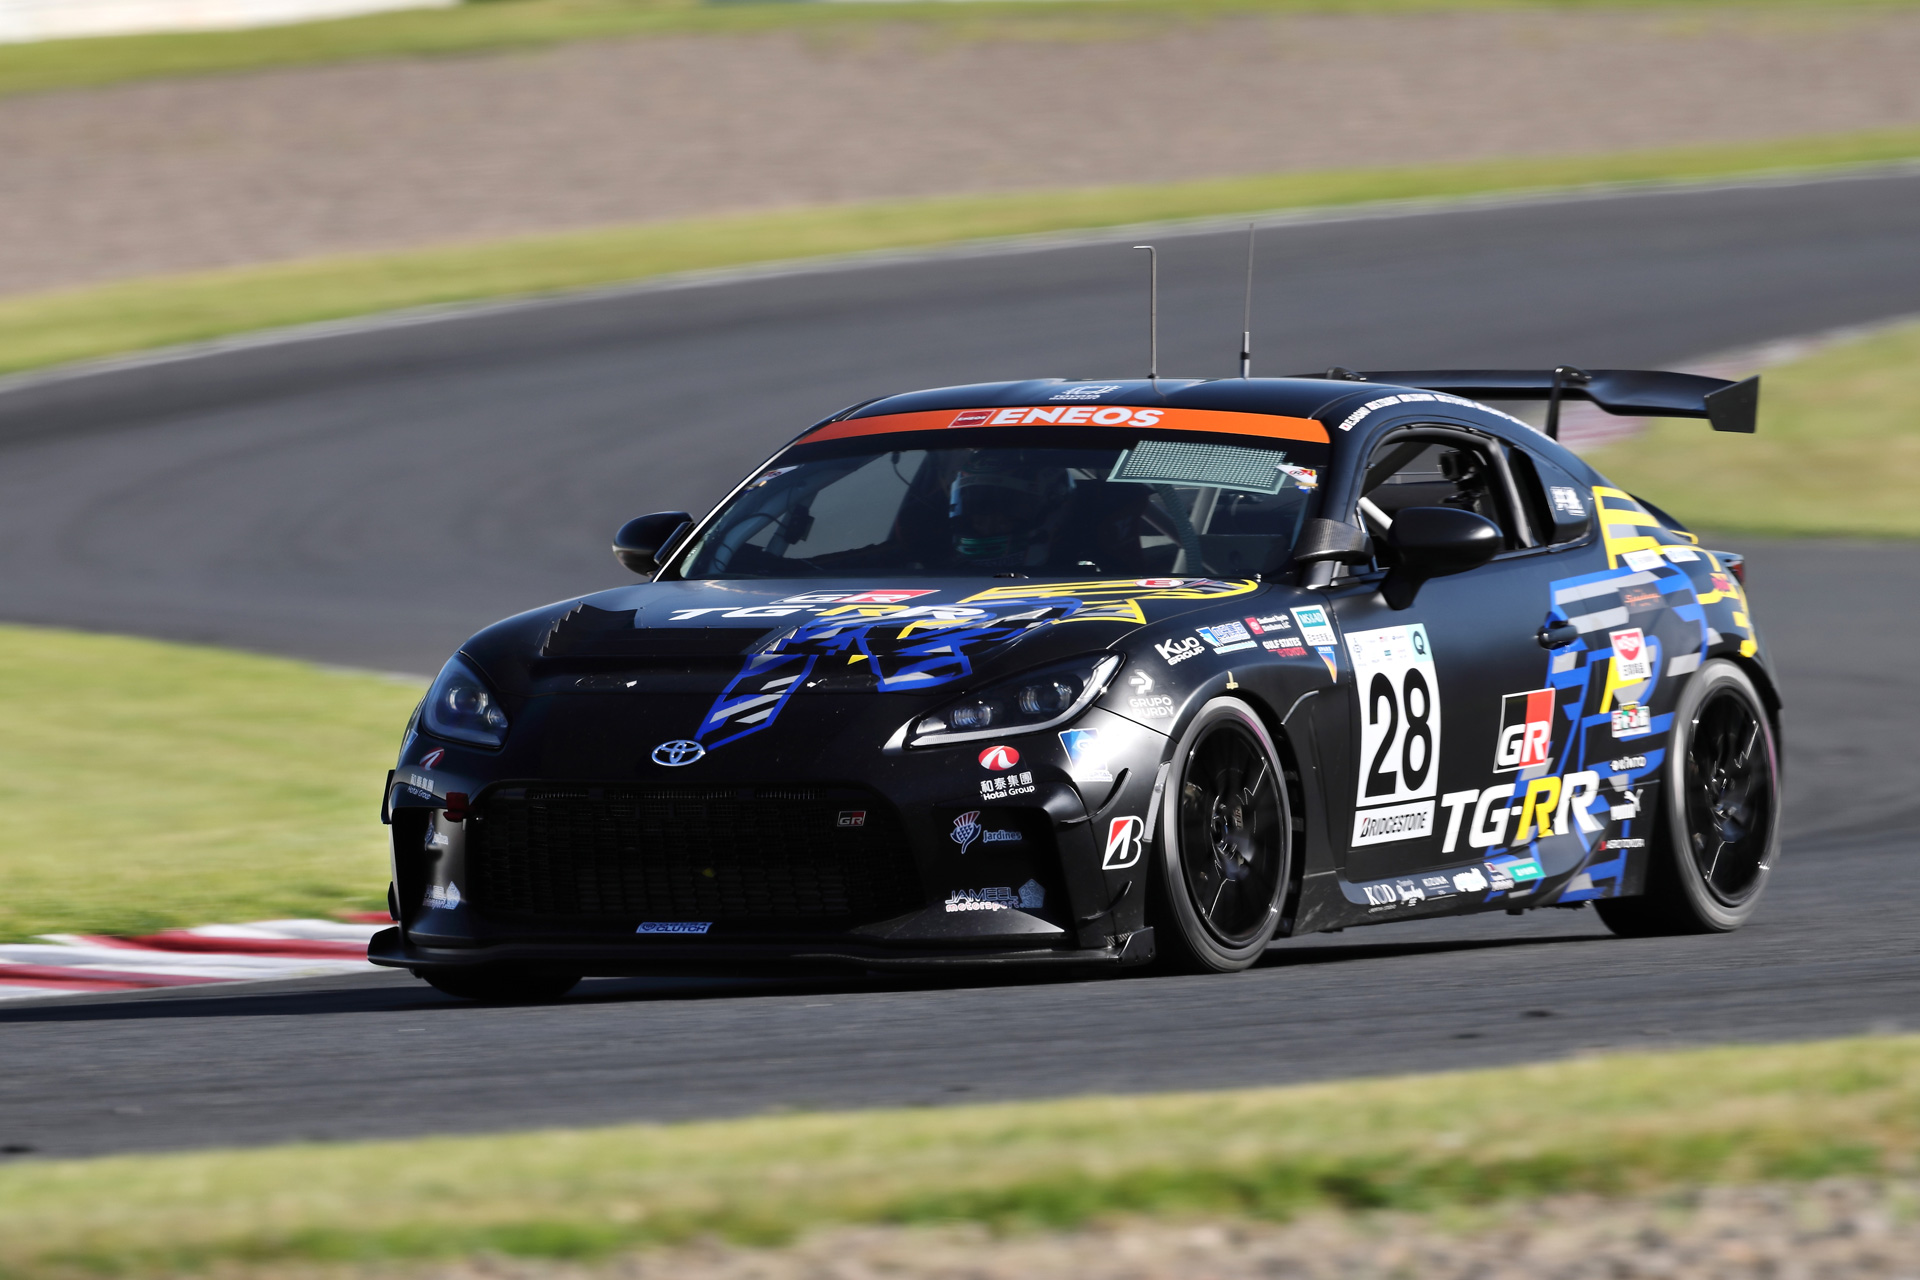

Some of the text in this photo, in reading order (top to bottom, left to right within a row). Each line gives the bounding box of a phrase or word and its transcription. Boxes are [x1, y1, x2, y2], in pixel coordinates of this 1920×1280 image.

[990, 407, 1165, 427] ENEOS
[1262, 639, 1280, 650] GULF
[1279, 637, 1302, 648] STATES
[1413, 630, 1427, 655] Q
[1167, 645, 1205, 666] GROUP
[1129, 696, 1172, 708] GRUPO
[1365, 668, 1432, 798] 28
[1497, 720, 1550, 767] GR
[980, 771, 1033, 793] 和泰集團
[983, 784, 1036, 801] Hotai Group
[1441, 770, 1604, 854] TG-RR
[1360, 811, 1428, 838] BRIDGESTONE
[982, 829, 1023, 844] Jardines
[945, 887, 1019, 905] JAMEEL
[1363, 884, 1397, 906] KOD
